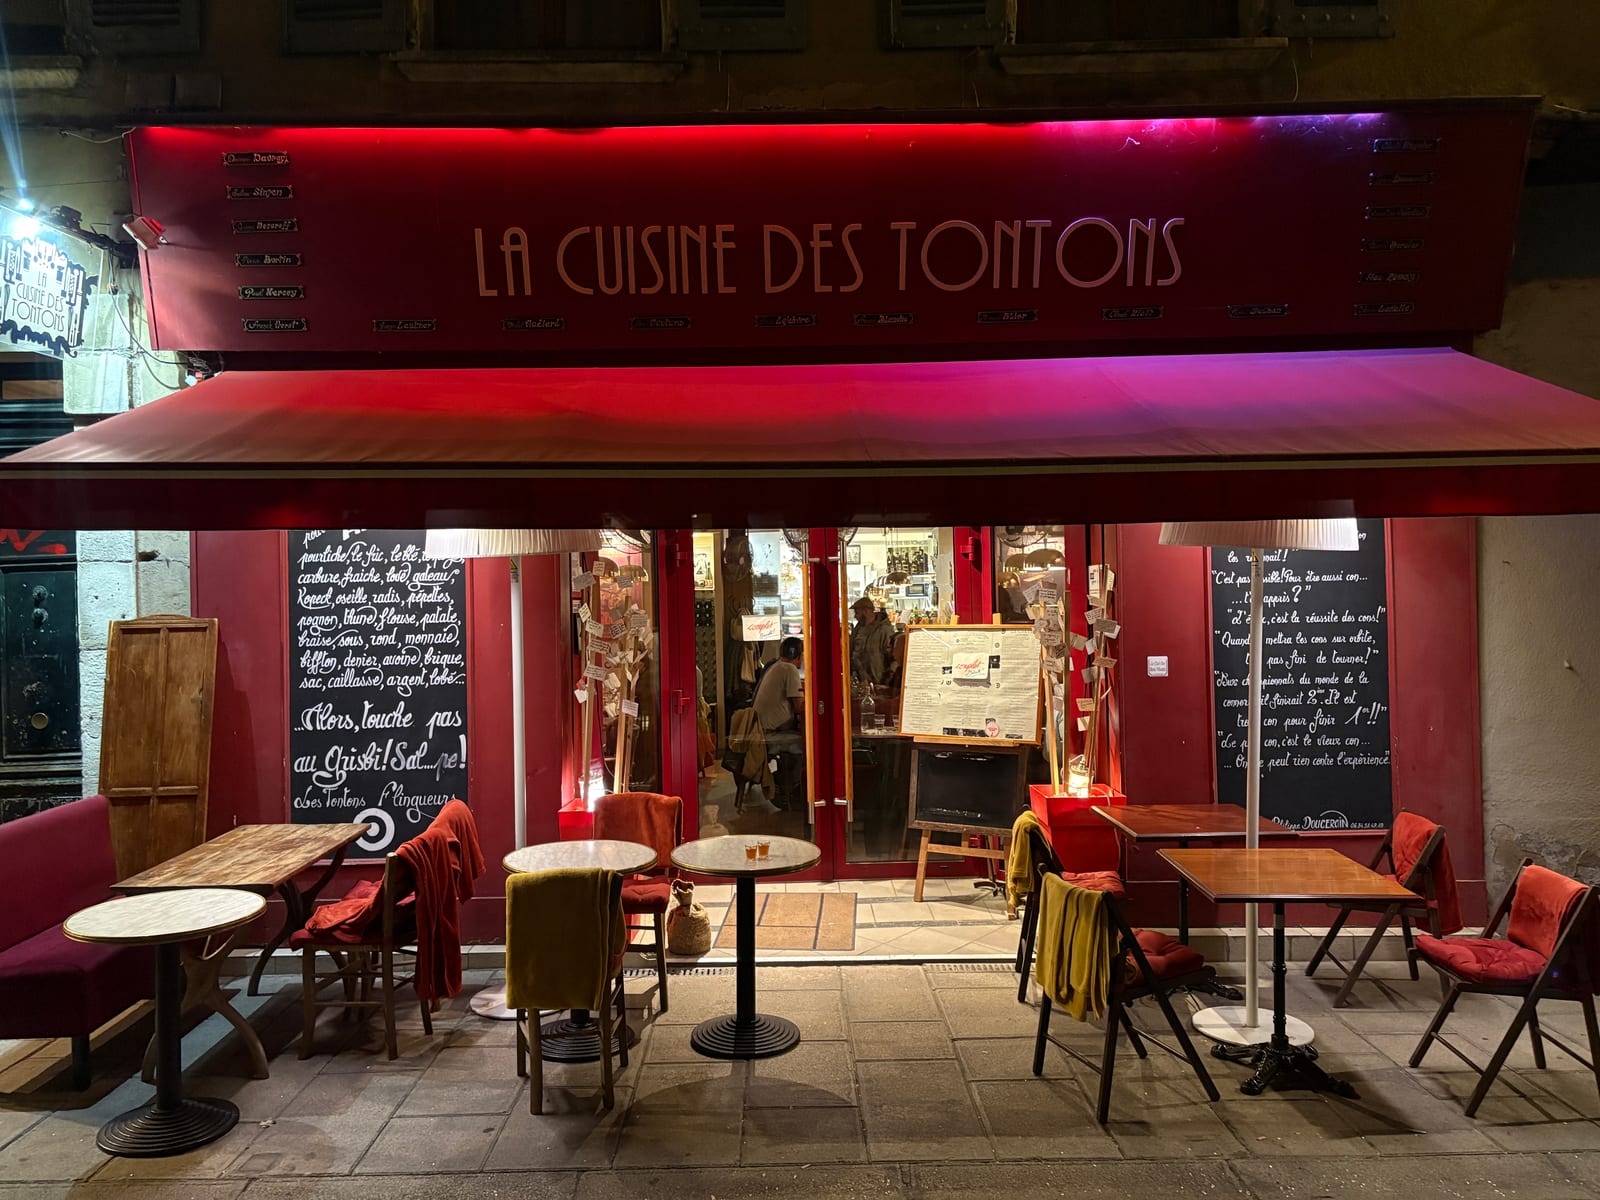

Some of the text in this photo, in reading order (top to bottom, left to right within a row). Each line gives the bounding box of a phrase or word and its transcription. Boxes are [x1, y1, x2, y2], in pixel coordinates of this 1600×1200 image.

[474, 217, 1185, 296] LA CUISINE DES TONTONS
[37, 271, 47, 288] LA
[16, 282, 64, 312] CUISINE DES
[12, 298, 65, 332] TONTONS
[362, 700, 415, 729] touche
[426, 710, 463, 739] pas
[293, 755, 317, 772] au
[322, 786, 367, 809] Tontons
